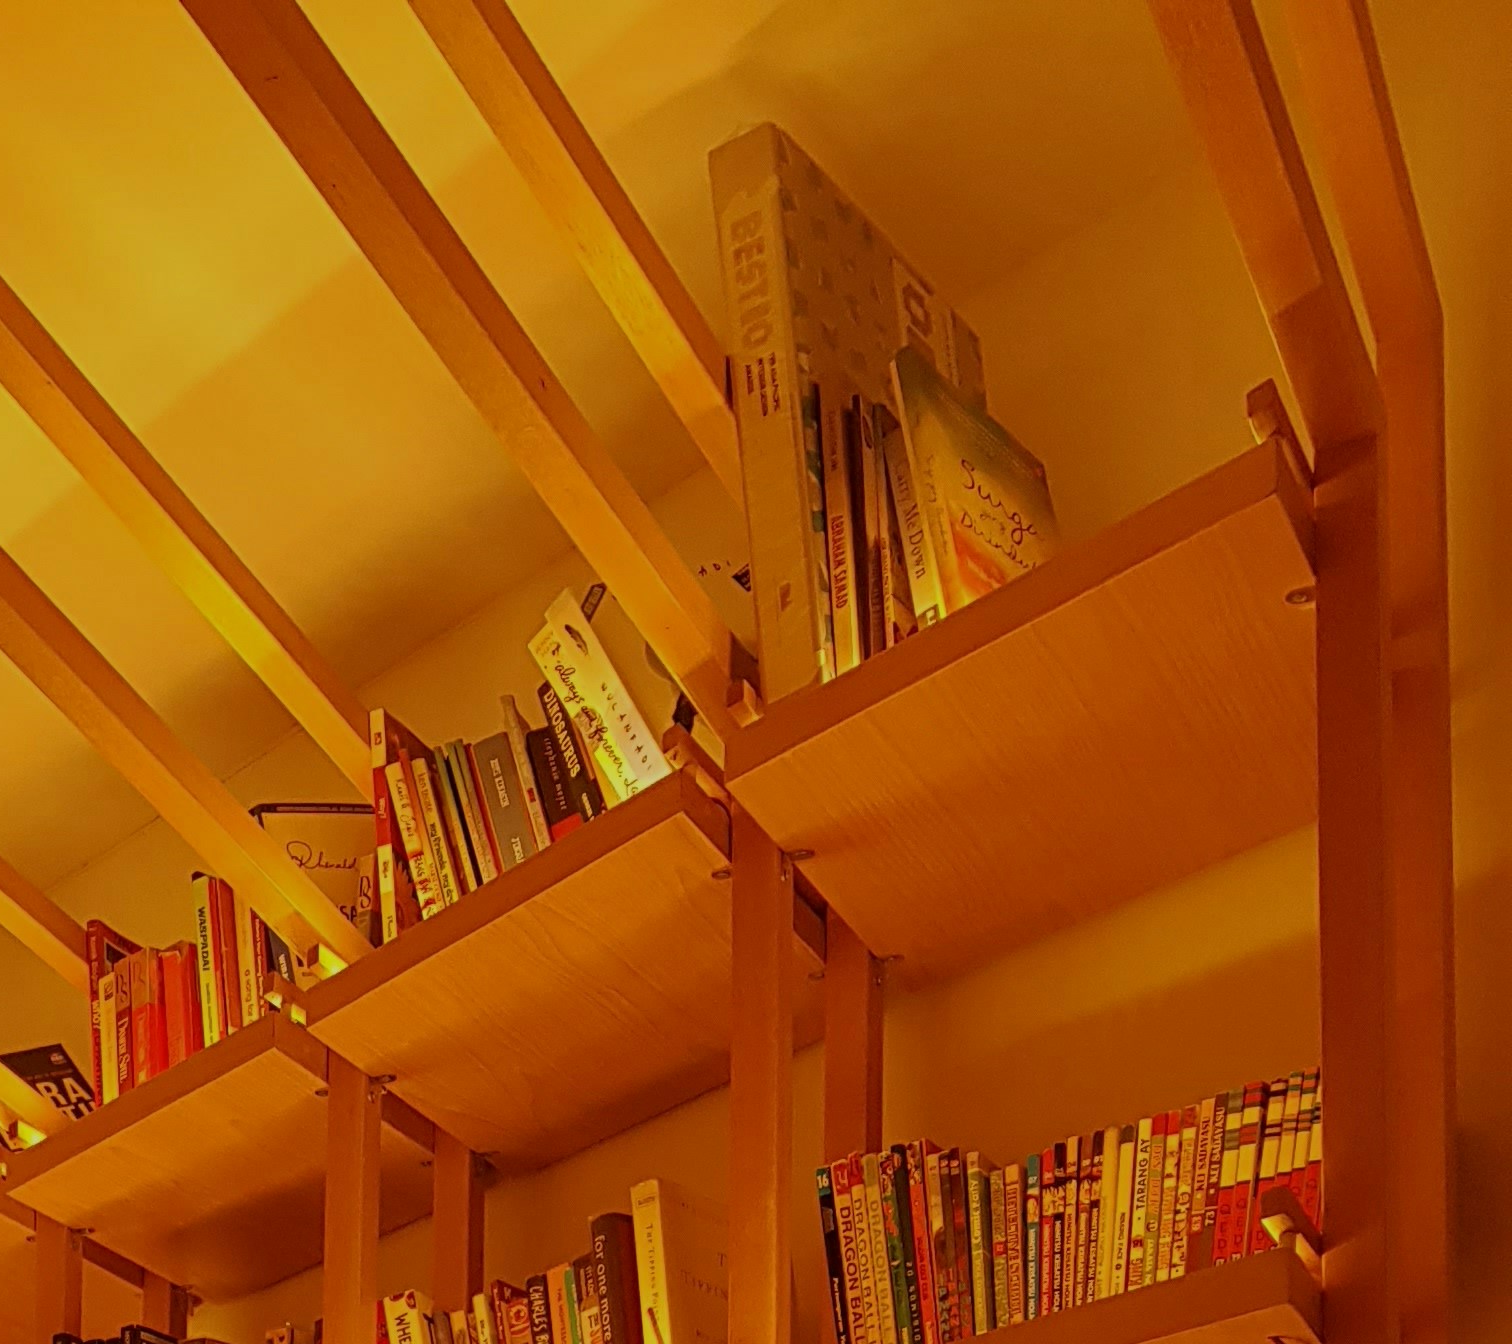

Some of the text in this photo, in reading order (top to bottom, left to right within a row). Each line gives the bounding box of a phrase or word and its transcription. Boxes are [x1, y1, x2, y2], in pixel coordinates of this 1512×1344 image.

[830, 515, 849, 608] ABRAHAM SAMAD
[909, 526, 926, 579] Down
[556, 657, 582, 701] always
[545, 688, 582, 778] DINOSAURUS
[817, 1174, 829, 1189] 16
[1136, 1159, 1148, 1210] TARANG
[594, 1236, 606, 1258] for
[840, 1206, 859, 1291] DRAGON
[854, 1198, 870, 1283] DRAGON
[870, 1200, 887, 1282] DRAGON
[597, 1264, 610, 1292] one
[529, 1287, 545, 1331] CHARLES
[600, 1298, 615, 1338] more
